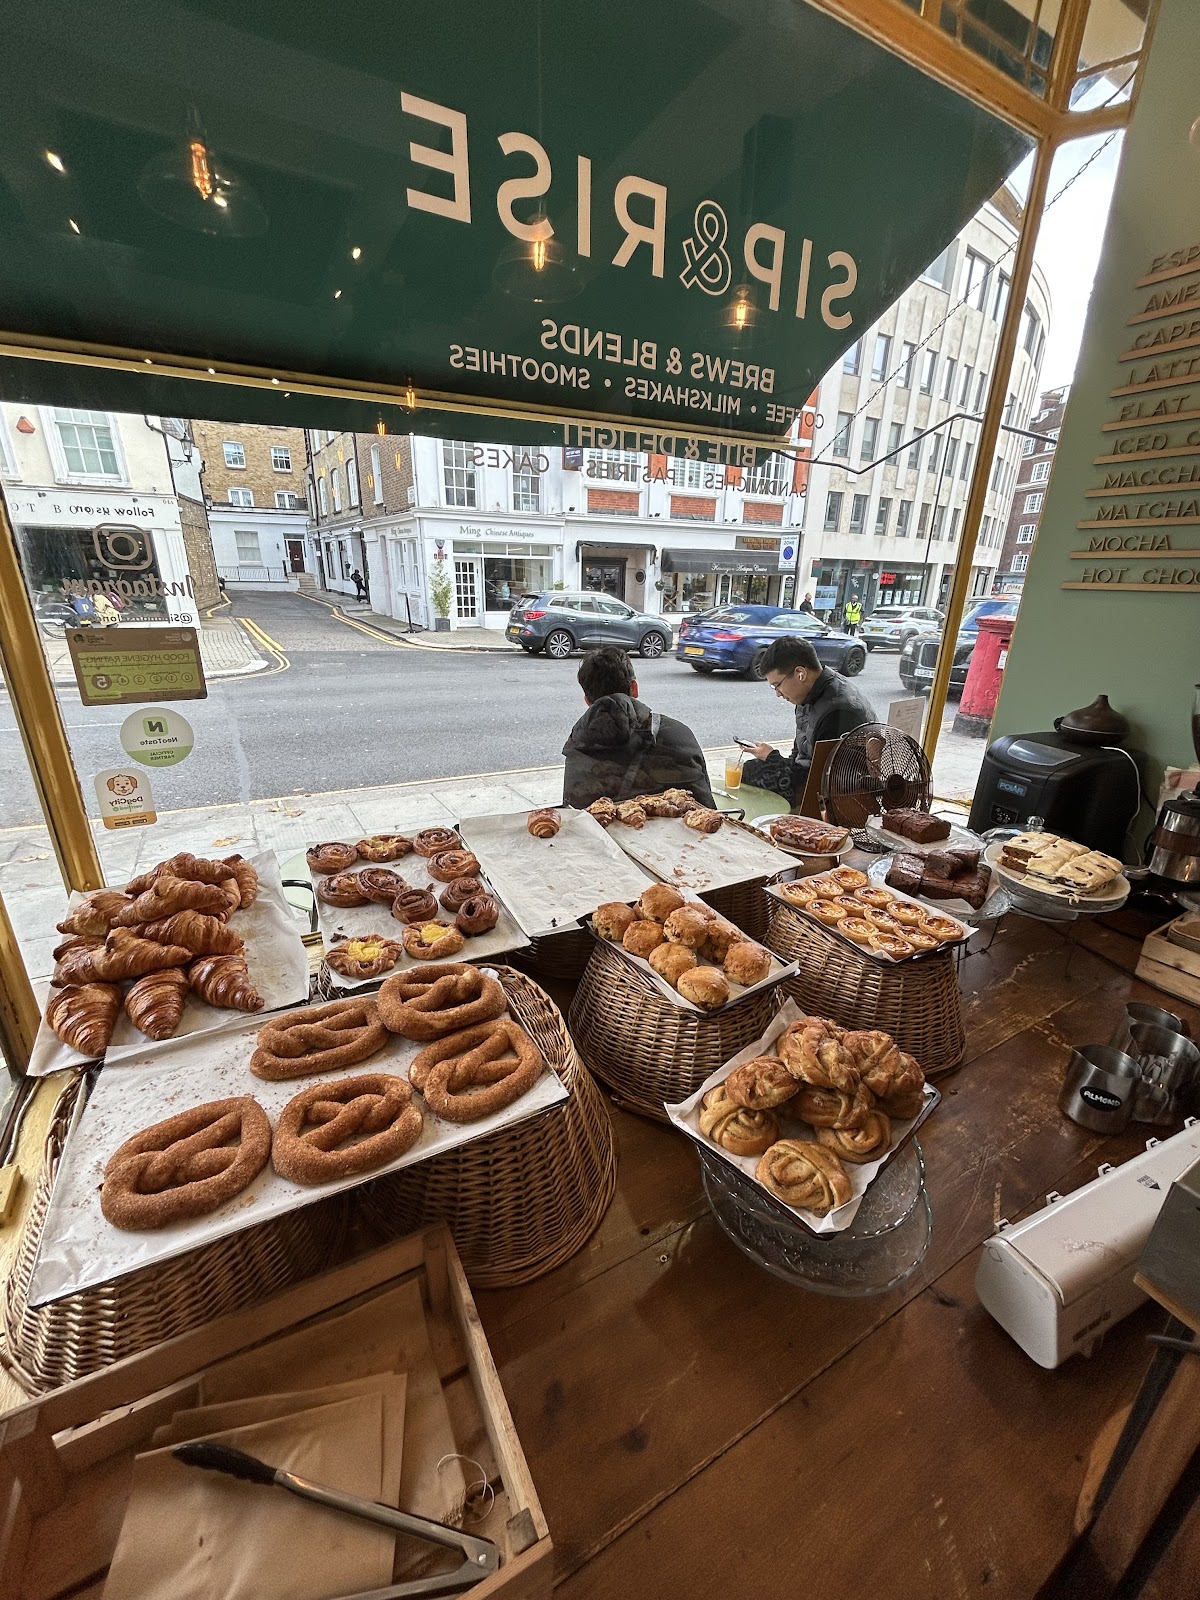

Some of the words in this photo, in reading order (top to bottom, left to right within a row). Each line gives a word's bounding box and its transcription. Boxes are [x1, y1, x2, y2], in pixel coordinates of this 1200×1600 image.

[1120, 395, 1191, 420] FLAT
[1111, 433, 1169, 456] ICED
[1095, 500, 1200, 521] MATCHA
[459, 525, 481, 538] Ming
[485, 528, 508, 537] Chinese
[509, 529, 534, 540] Antiques
[1088, 534, 1172, 552] MOCHA
[1081, 567, 1128, 584] HOT
[999, 781, 1024, 796] POLAR
[1083, 1090, 1121, 1107] ALMOND
